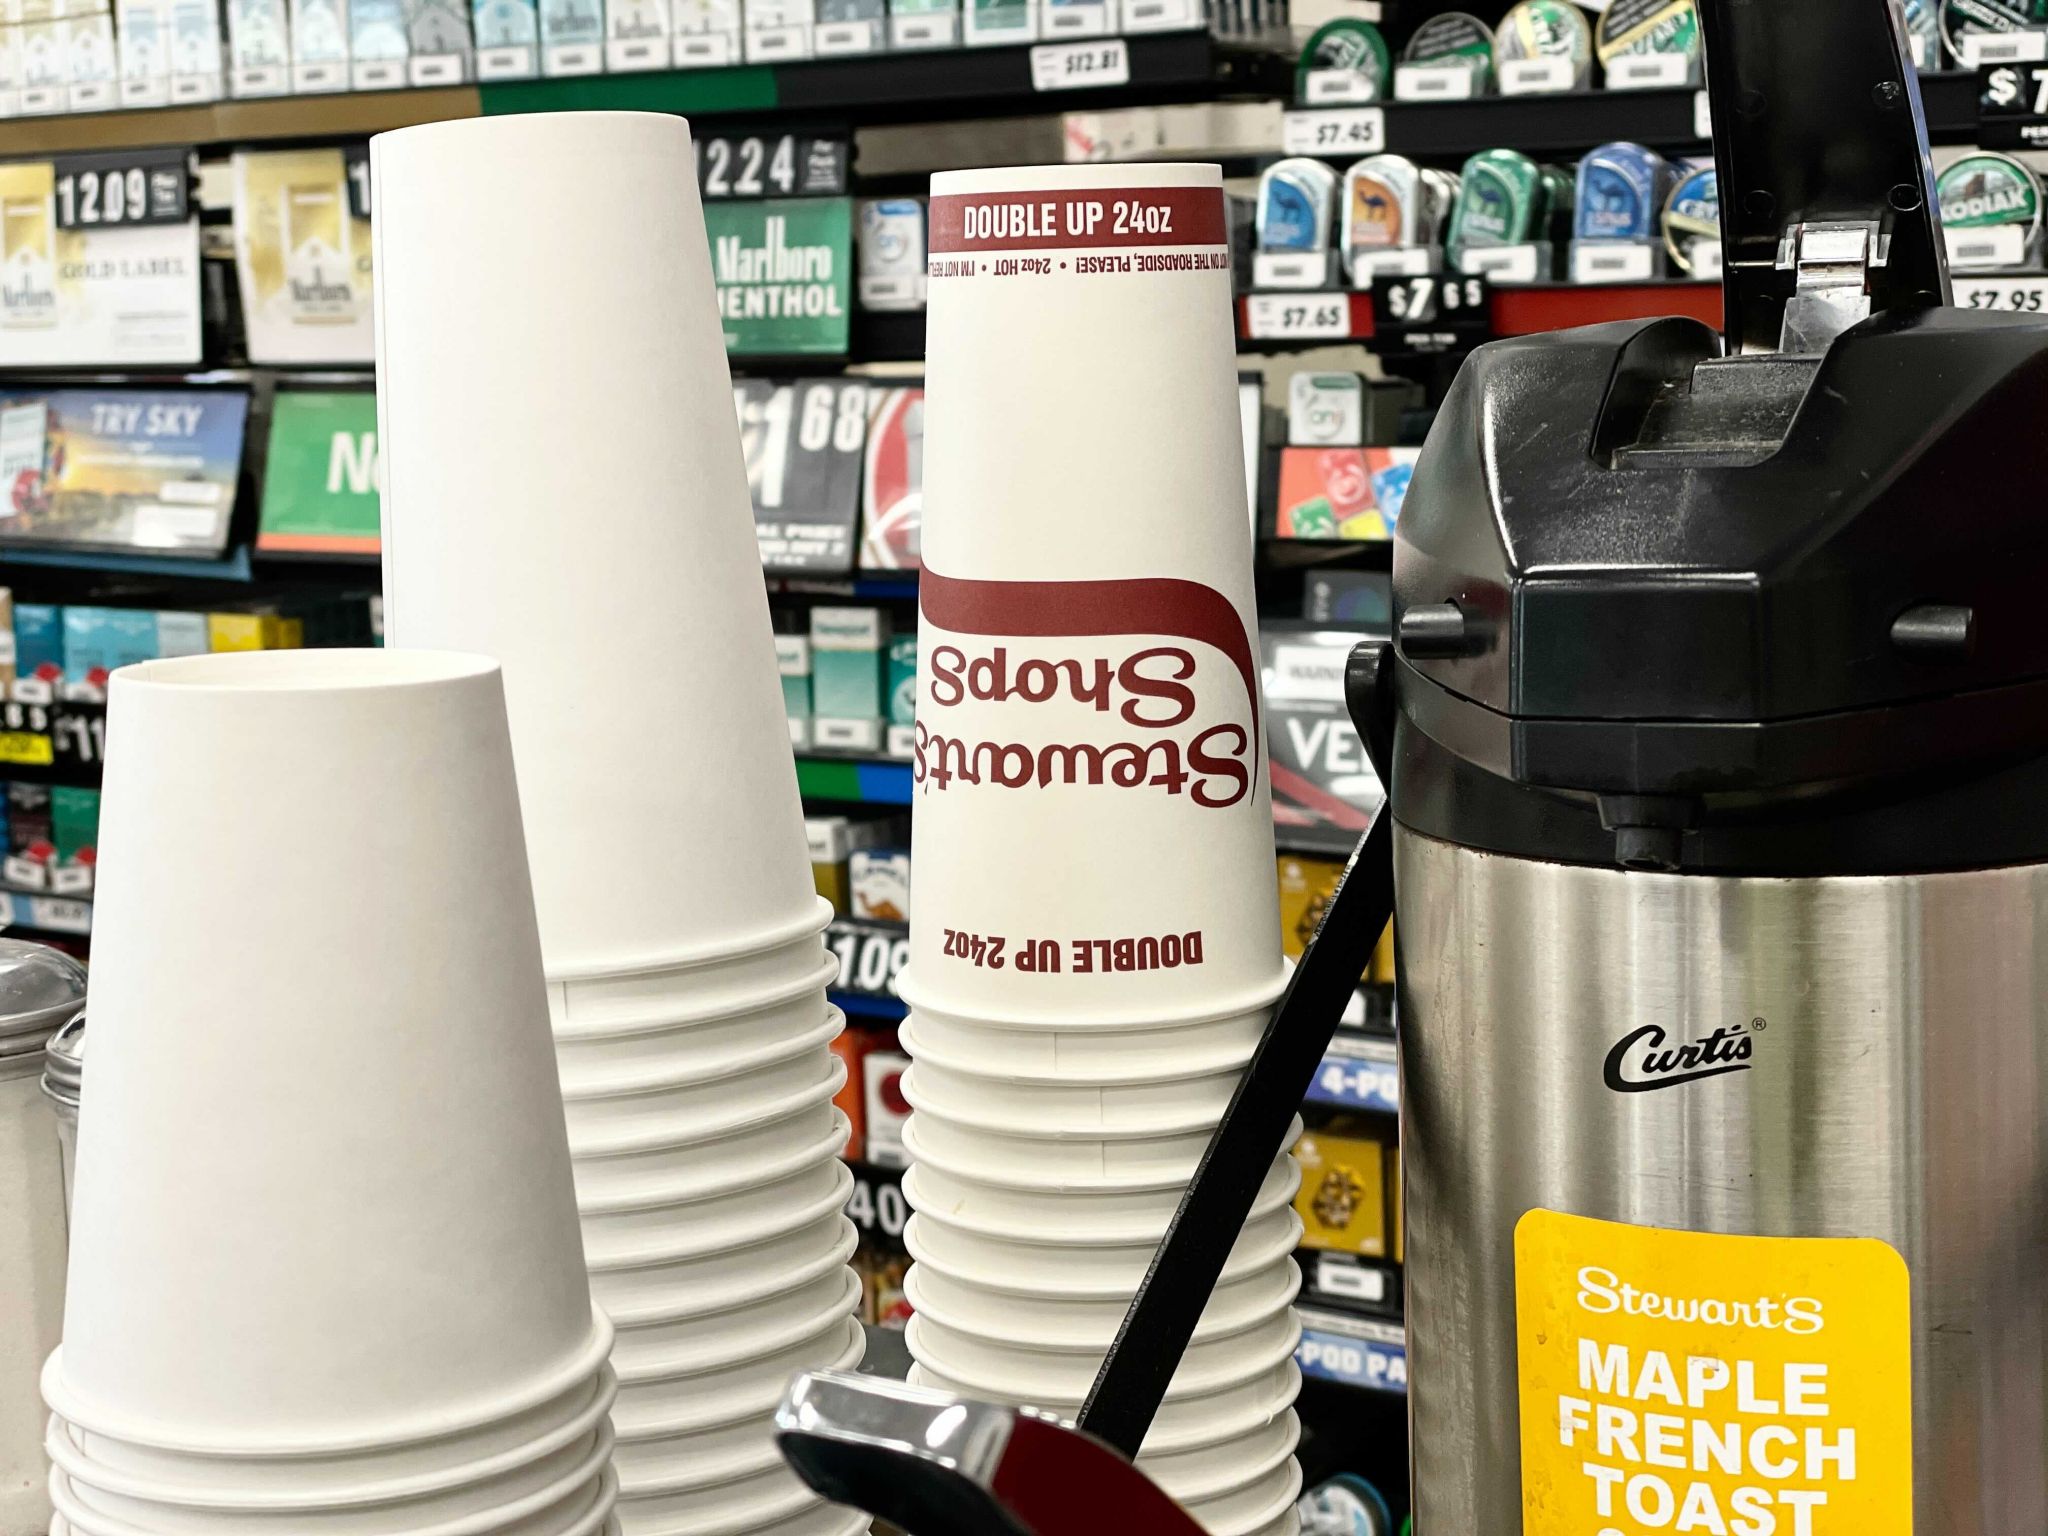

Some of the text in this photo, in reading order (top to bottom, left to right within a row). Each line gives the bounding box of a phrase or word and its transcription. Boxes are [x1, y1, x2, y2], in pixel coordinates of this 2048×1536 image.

[1316, 121, 1374, 145] $7.45
[964, 200, 1173, 239] DOUBLE UP 24oz
[716, 215, 833, 283] Marlboro
[1076, 255, 1131, 274] PLEASE!
[1134, 252, 1193, 272] ROADSIDE,
[1195, 253, 1210, 269] THE
[944, 261, 959, 277] NOT
[994, 259, 1018, 276] HOT
[1284, 305, 1341, 328] $7.65
[90, 403, 204, 436] TRY SKY
[931, 645, 1196, 728] Shops
[1015, 939, 1061, 973] UP
[1072, 930, 1203, 973] DOUBLE
[1603, 1024, 1753, 1092] Curtis
[1577, 1337, 1830, 1416] MAPLE
[1558, 1394, 1857, 1480] FRENCH
[1582, 1461, 1828, 1536] TOAST
